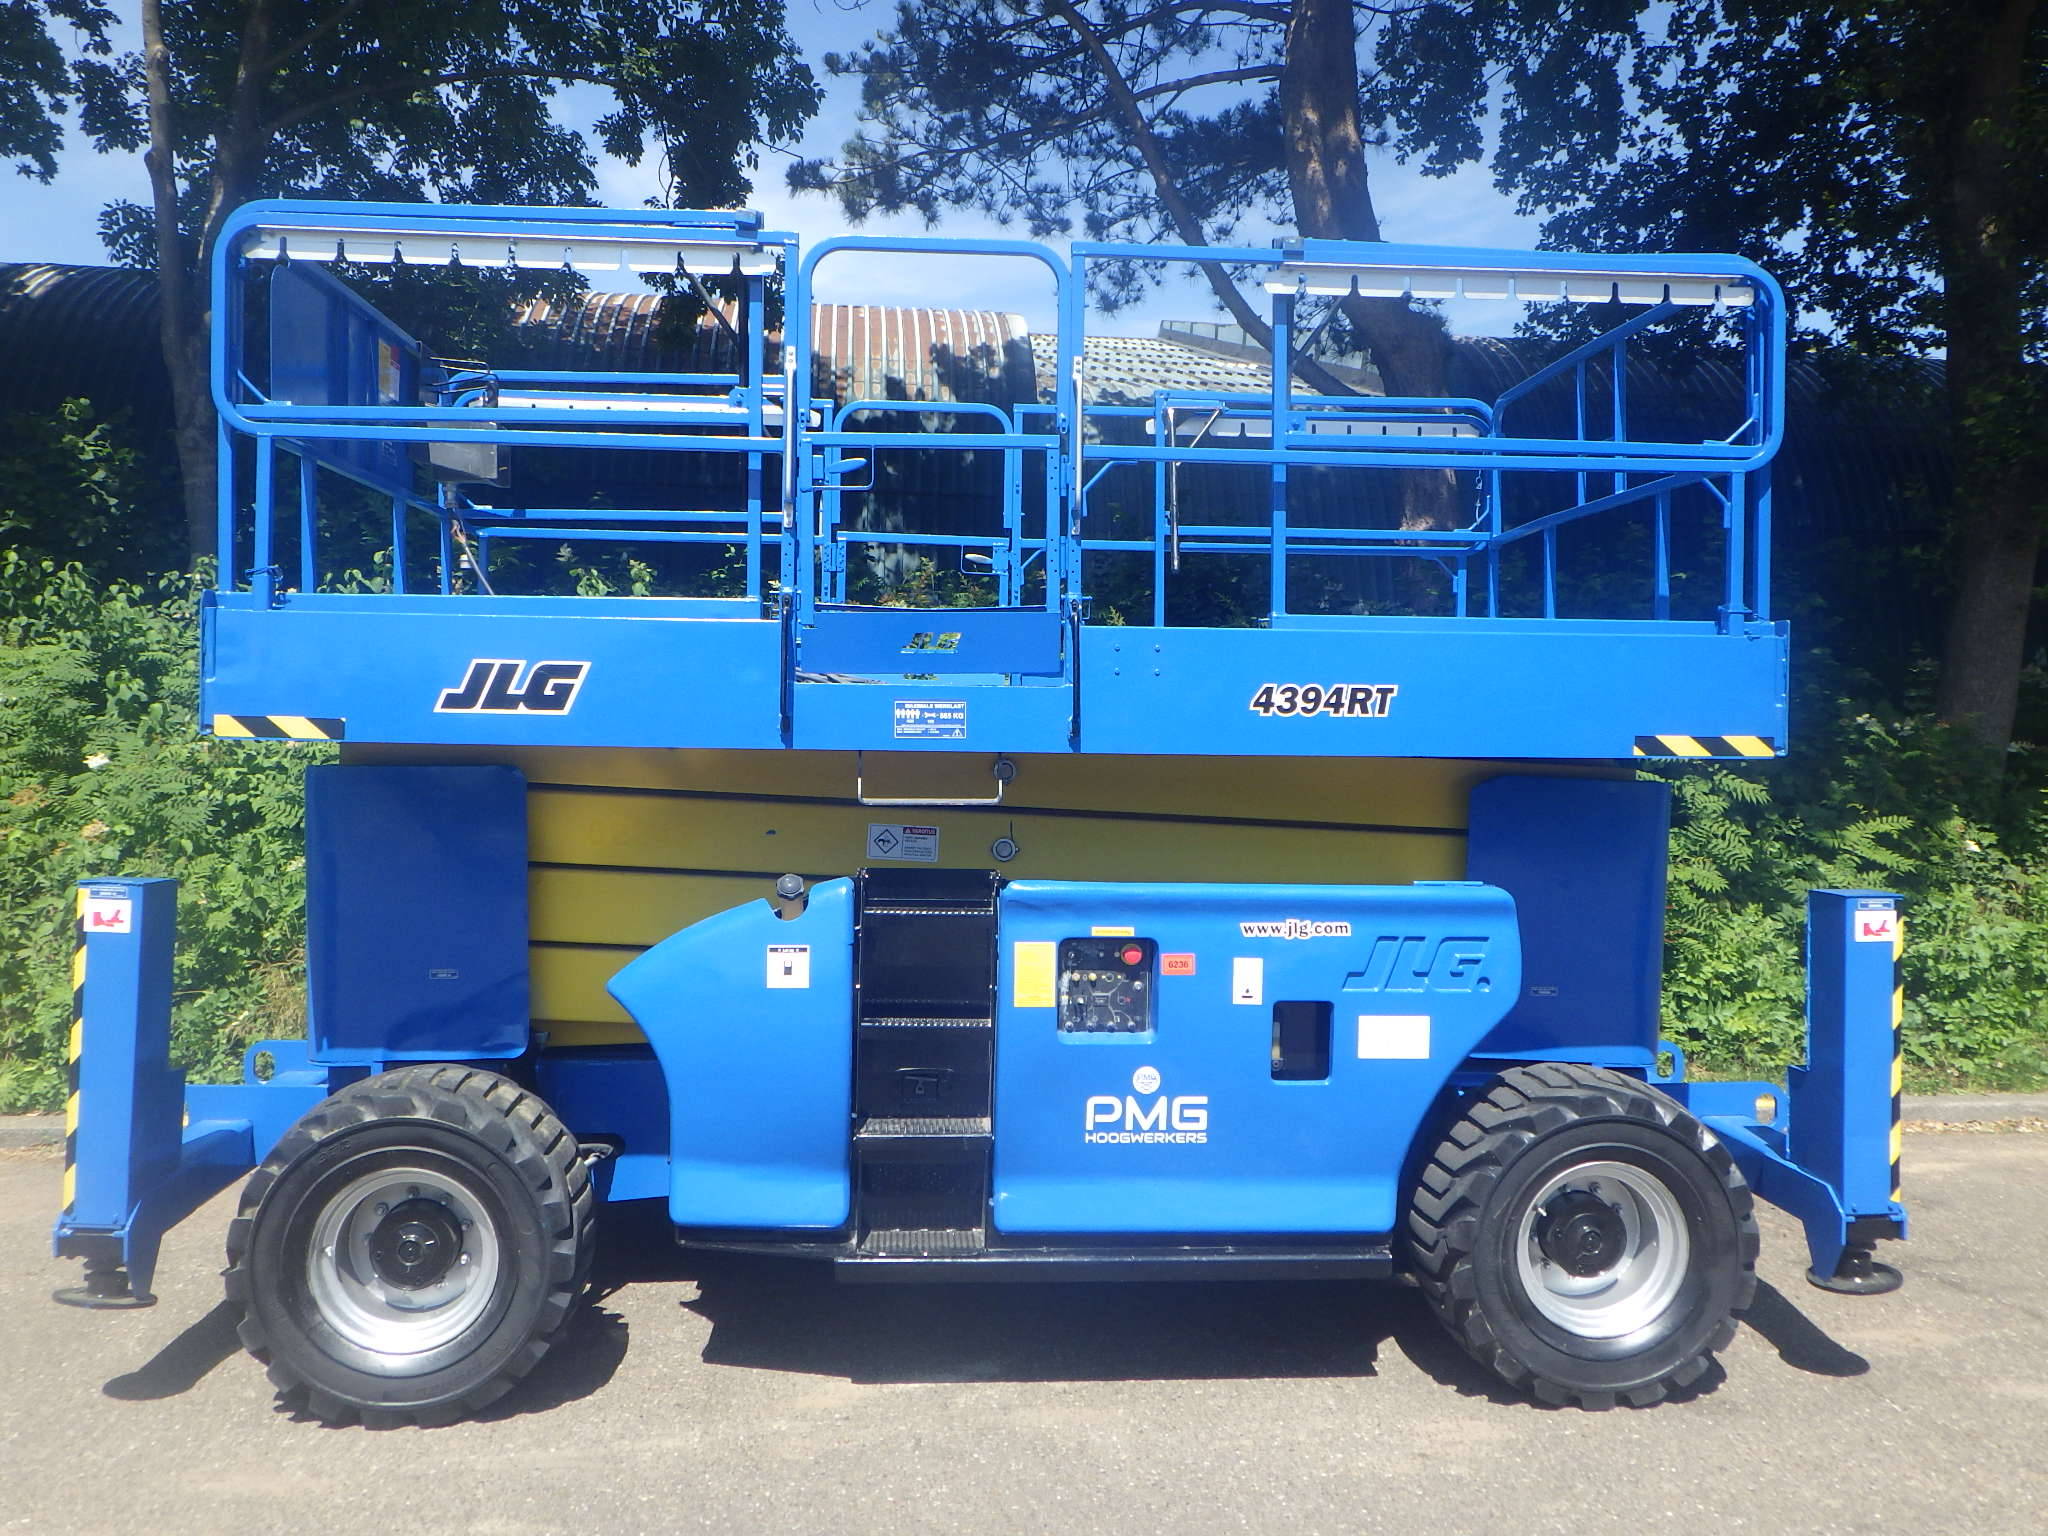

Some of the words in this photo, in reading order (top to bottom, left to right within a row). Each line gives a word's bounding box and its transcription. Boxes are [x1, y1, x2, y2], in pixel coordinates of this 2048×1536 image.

[434, 659, 591, 714] JLG
[1251, 684, 1397, 716] 4394RT
[1241, 920, 1350, 938] www.jlg.com
[1085, 1095, 1208, 1131] PMG
[1085, 1132, 1207, 1144] HOOGWERKERS
